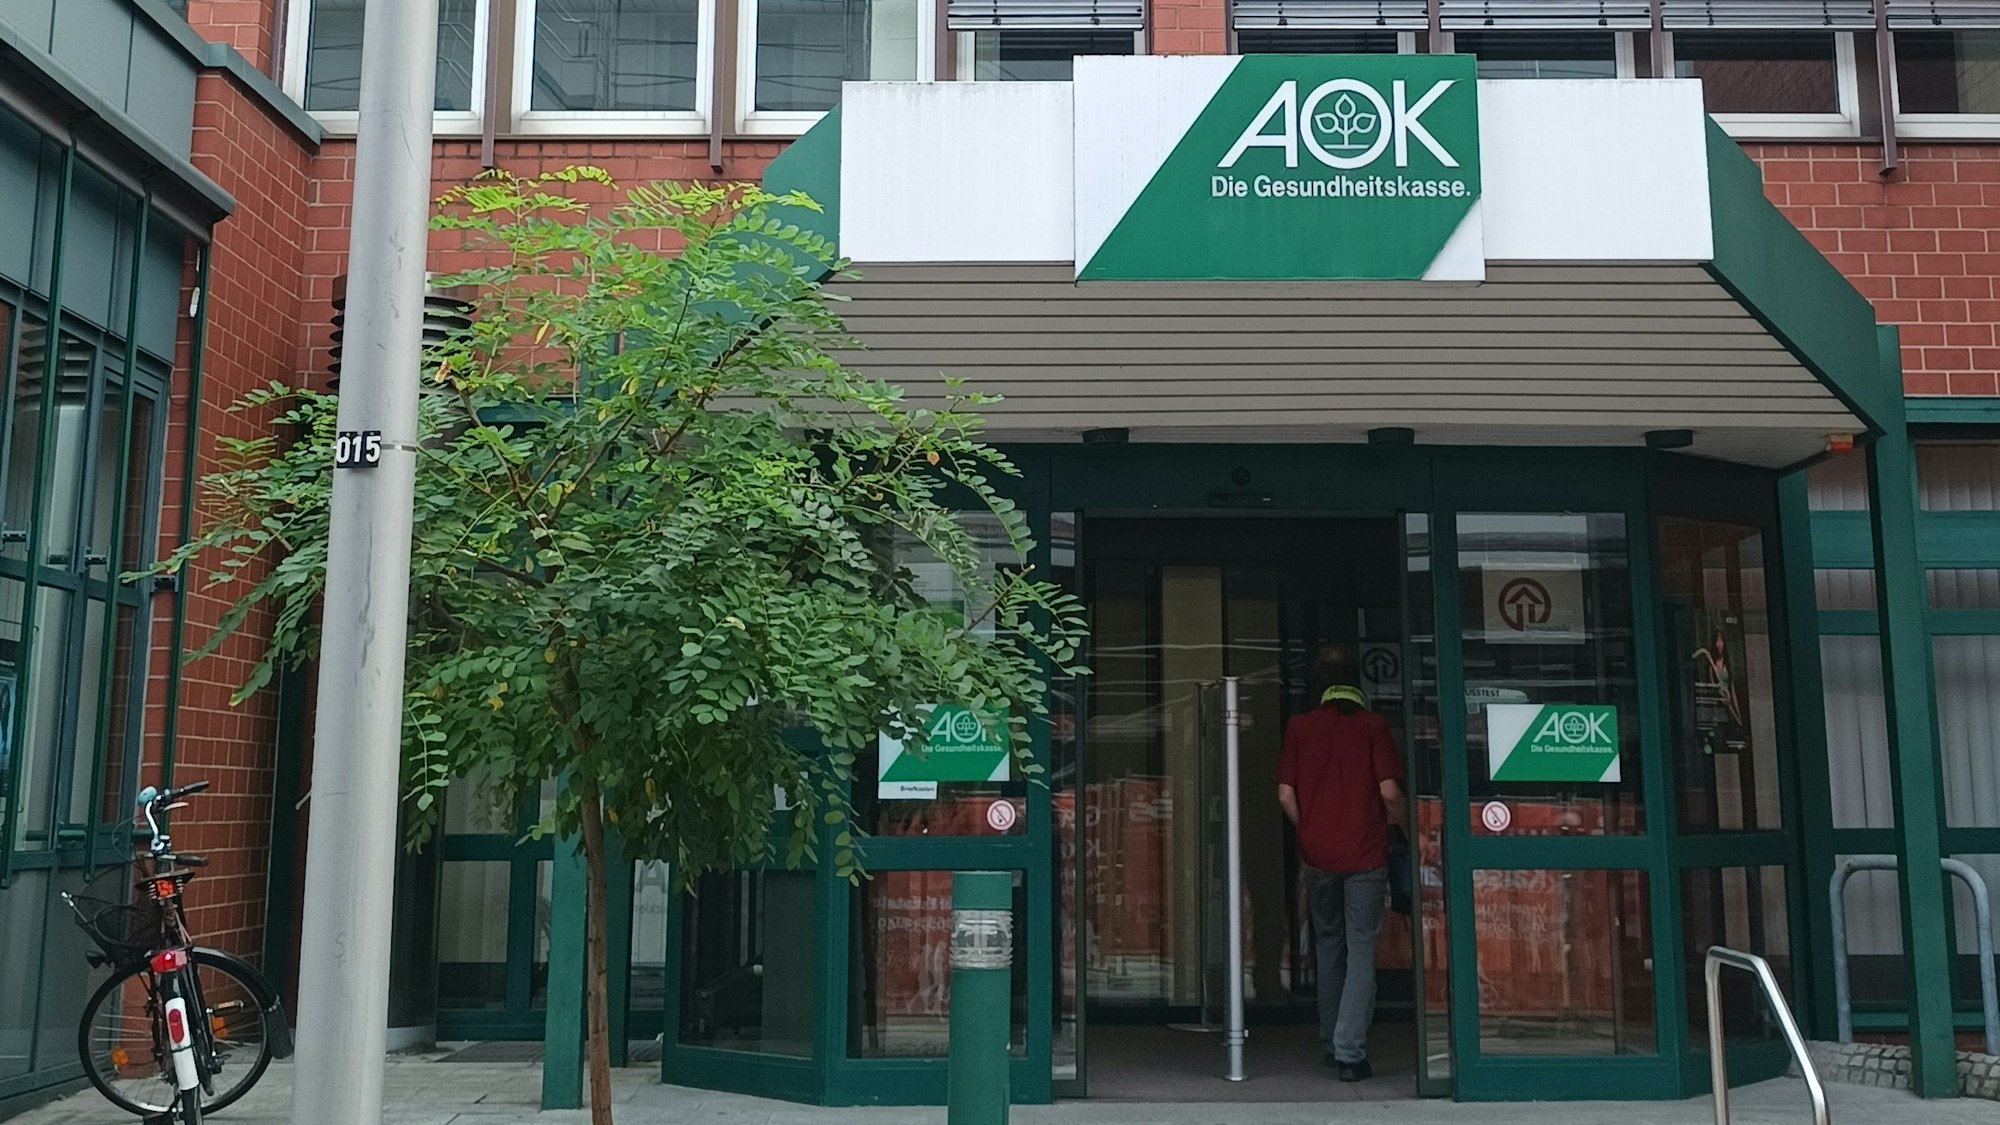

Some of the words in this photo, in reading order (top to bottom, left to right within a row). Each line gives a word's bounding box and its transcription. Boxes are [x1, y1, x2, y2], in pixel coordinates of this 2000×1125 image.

[1217, 78, 1461, 169] AOK
[1211, 175, 1248, 197] Die
[1254, 175, 1471, 197] Gesundheitskasse.
[336, 436, 381, 463] 015
[1533, 711, 1612, 744] AOK
